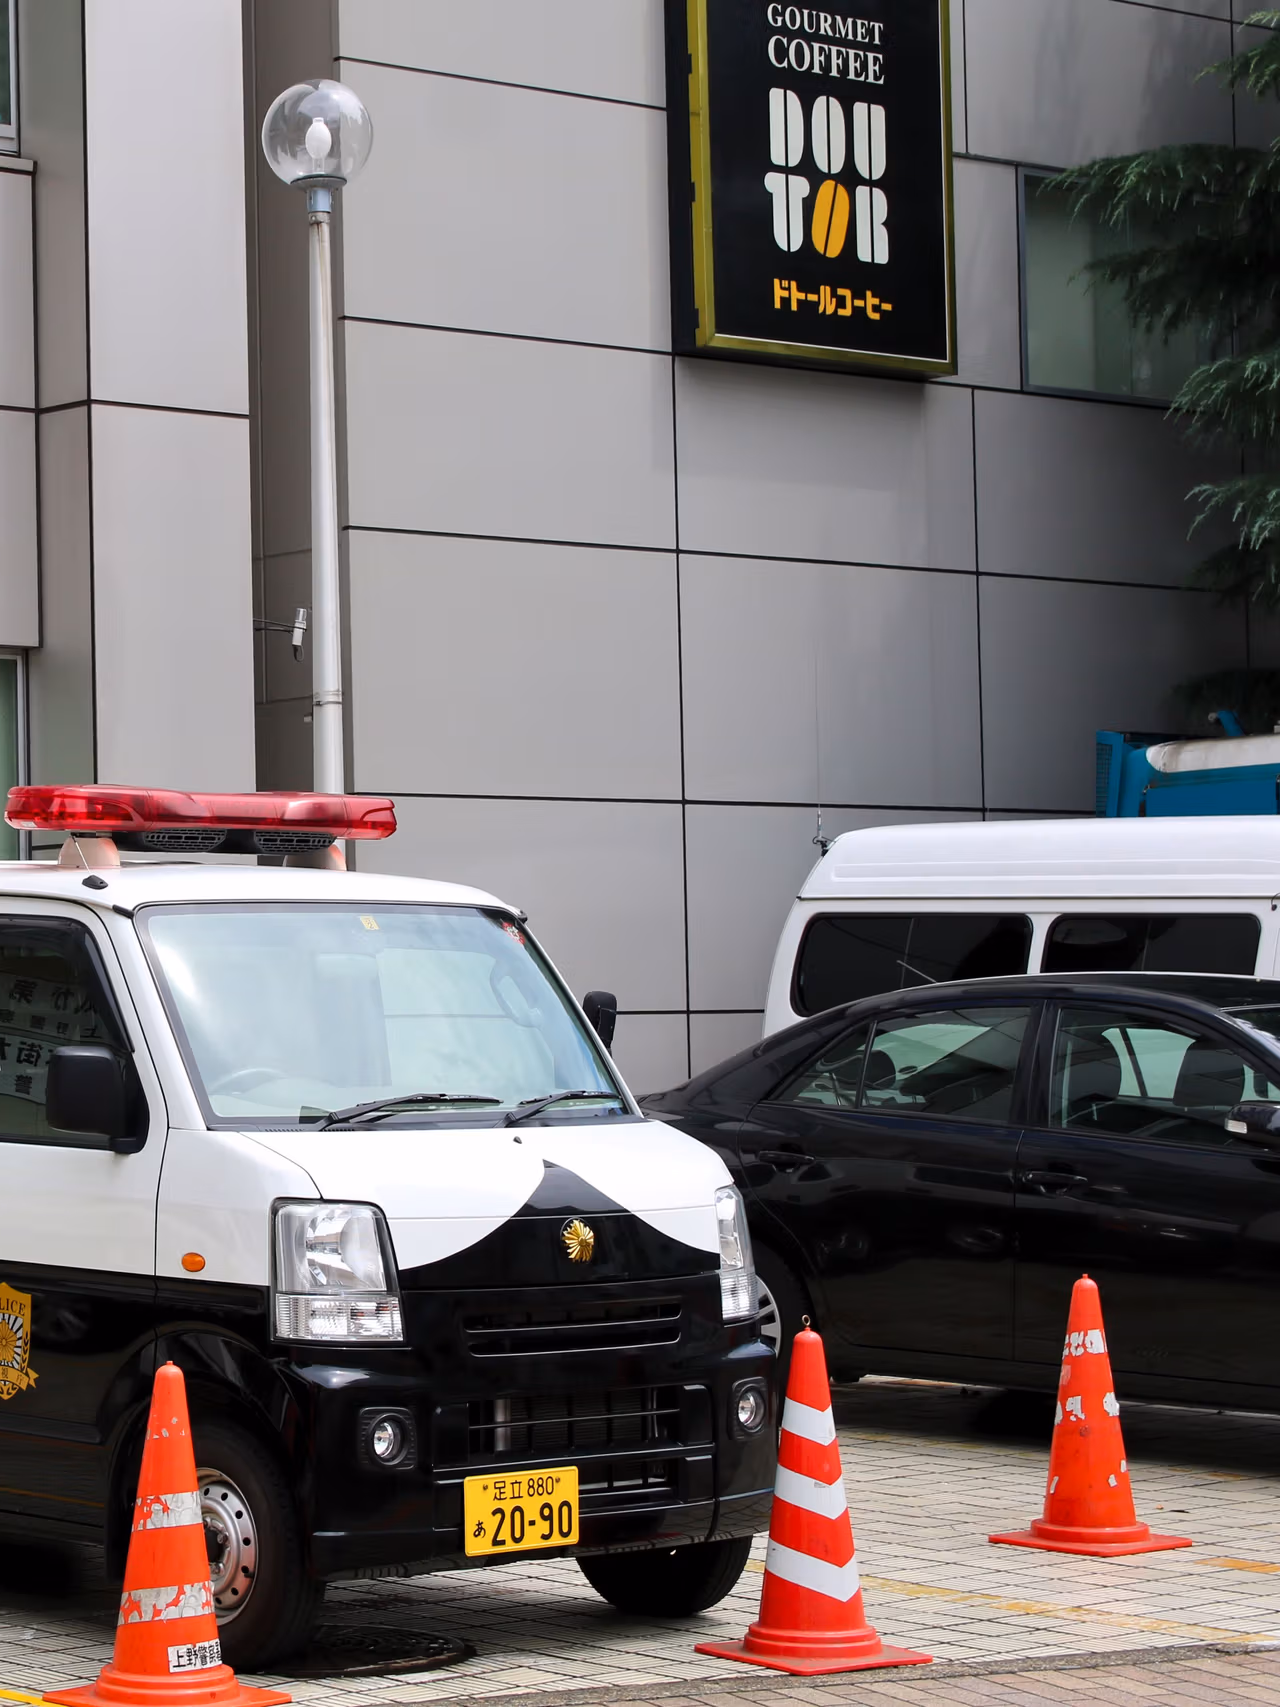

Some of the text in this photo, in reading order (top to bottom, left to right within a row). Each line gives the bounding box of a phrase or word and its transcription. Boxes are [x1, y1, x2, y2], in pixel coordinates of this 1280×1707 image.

[767, 3, 883, 44] GOURMET
[768, 35, 884, 84] COFFEE
[769, 87, 887, 181] DOU
[764, 172, 889, 265] TOR
[773, 278, 892, 320] ドトールコーヒー
[493, 1475, 555, 1501] 足立 880
[473, 1500, 573, 1547] あ 20-90
